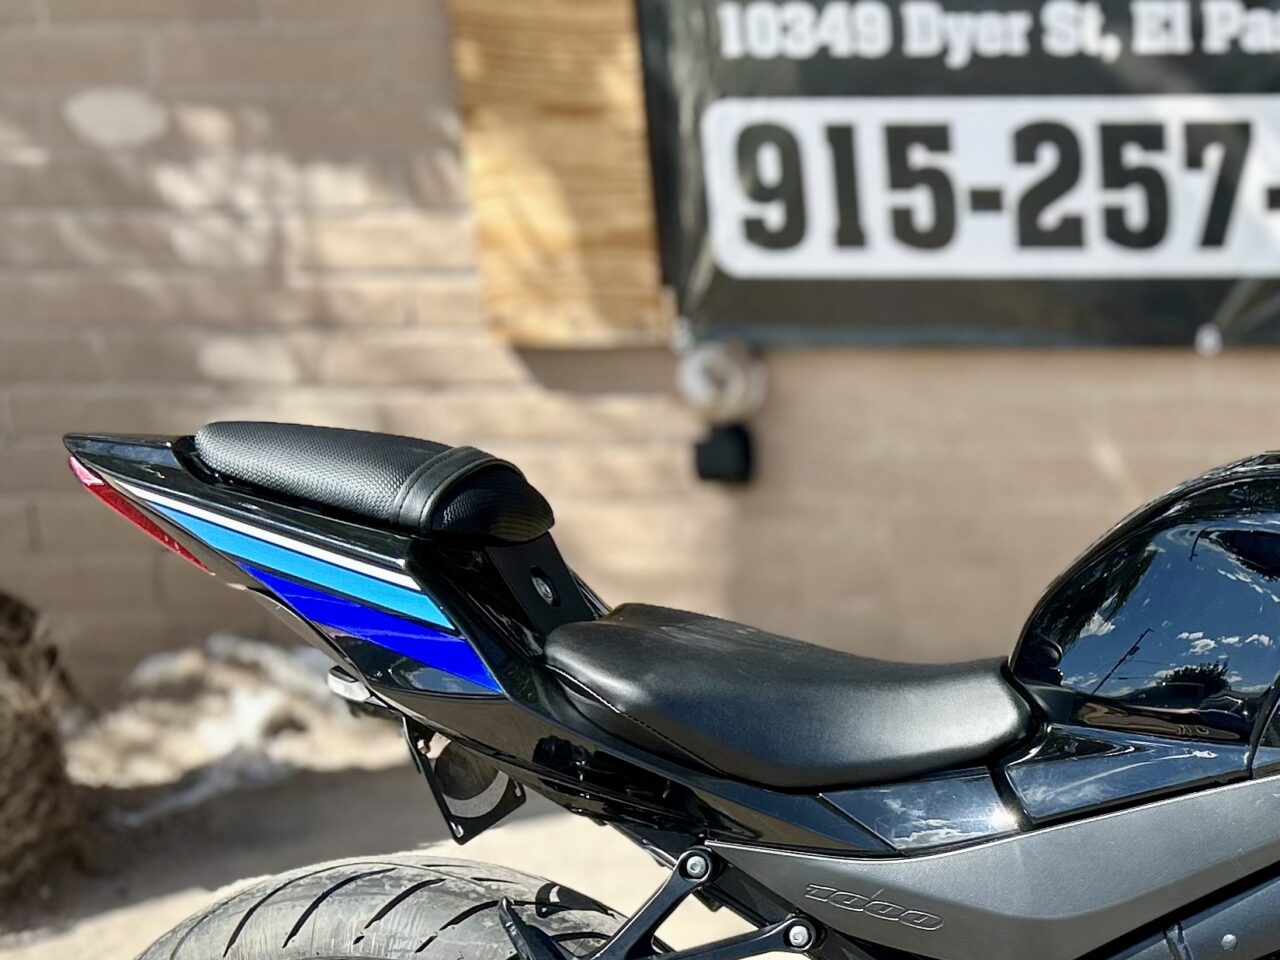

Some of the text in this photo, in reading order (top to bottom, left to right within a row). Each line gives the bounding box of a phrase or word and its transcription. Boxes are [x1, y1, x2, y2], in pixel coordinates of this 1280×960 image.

[718, 0, 892, 59] 10349
[903, 0, 1032, 69] Dyer
[1041, 0, 1122, 62] St,
[1131, 0, 1193, 55] El
